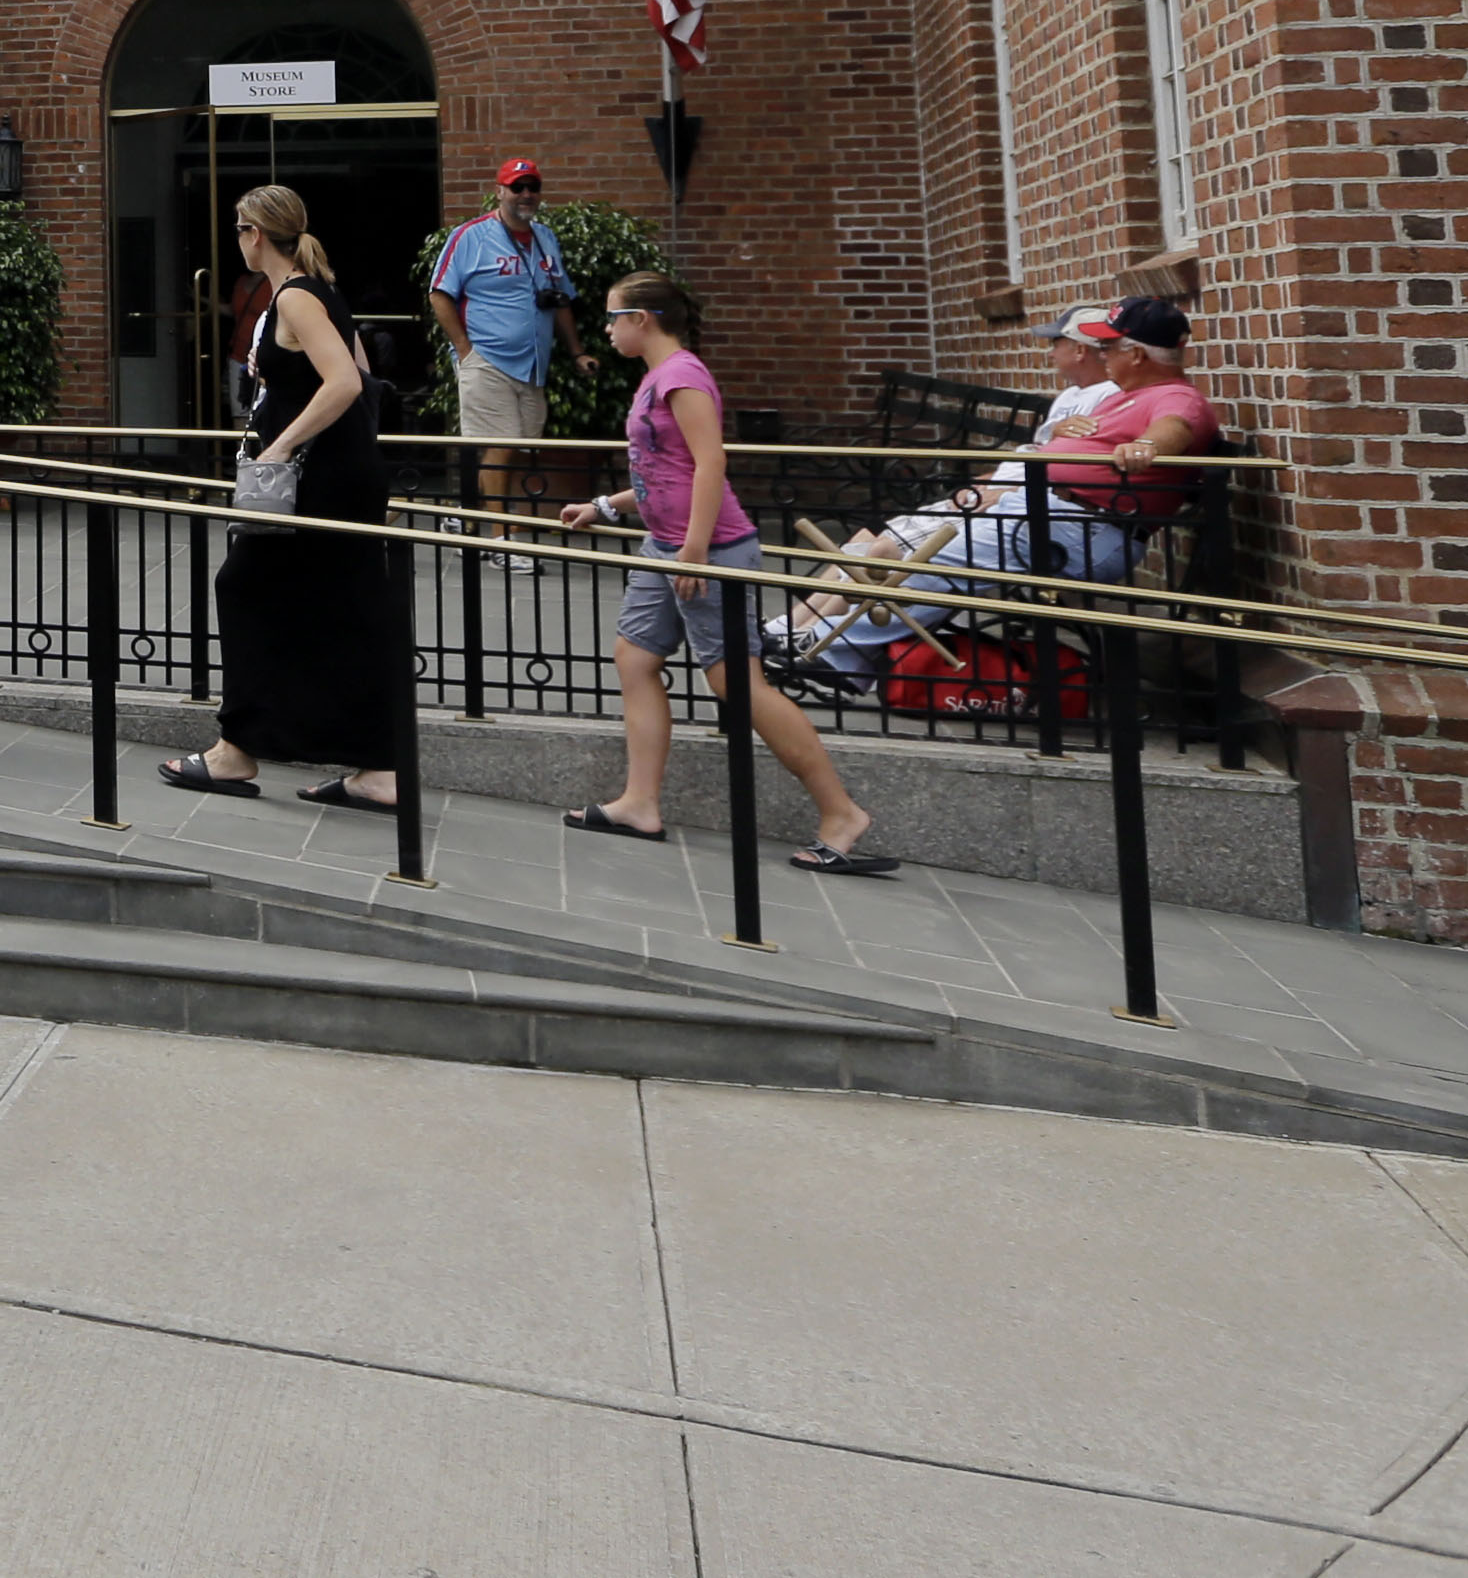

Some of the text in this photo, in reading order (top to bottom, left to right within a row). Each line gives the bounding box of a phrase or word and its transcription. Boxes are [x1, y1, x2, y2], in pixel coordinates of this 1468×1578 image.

[241, 70, 303, 82] MUSEUM
[249, 85, 296, 97] STORE
[496, 255, 520, 276] 27
